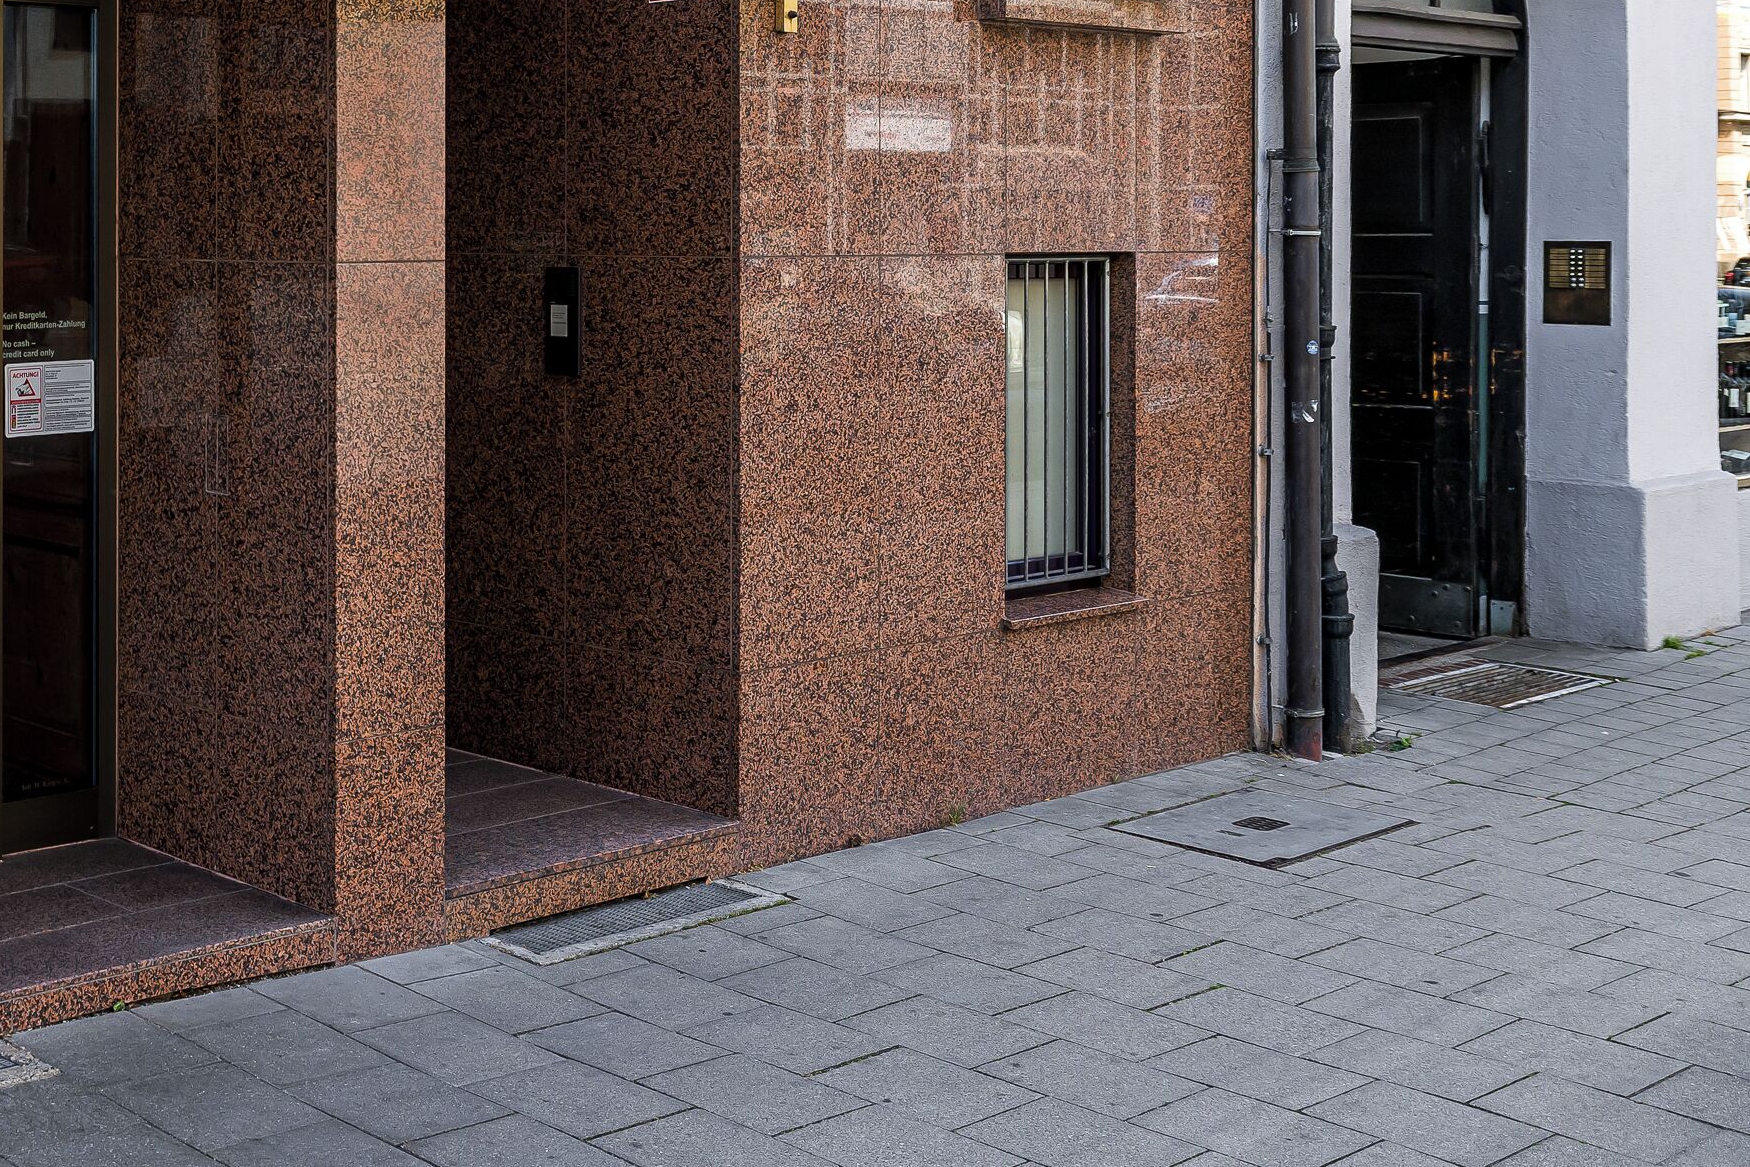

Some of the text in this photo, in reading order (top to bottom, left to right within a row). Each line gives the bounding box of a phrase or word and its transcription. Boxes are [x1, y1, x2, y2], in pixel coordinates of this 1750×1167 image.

[18, 310, 48, 321] Bargeld,
[2, 340, 12, 348] No
[13, 339, 30, 348] cash
[2, 348, 55, 359] credit card only
[12, 371, 39, 379] ACHTUNG!
